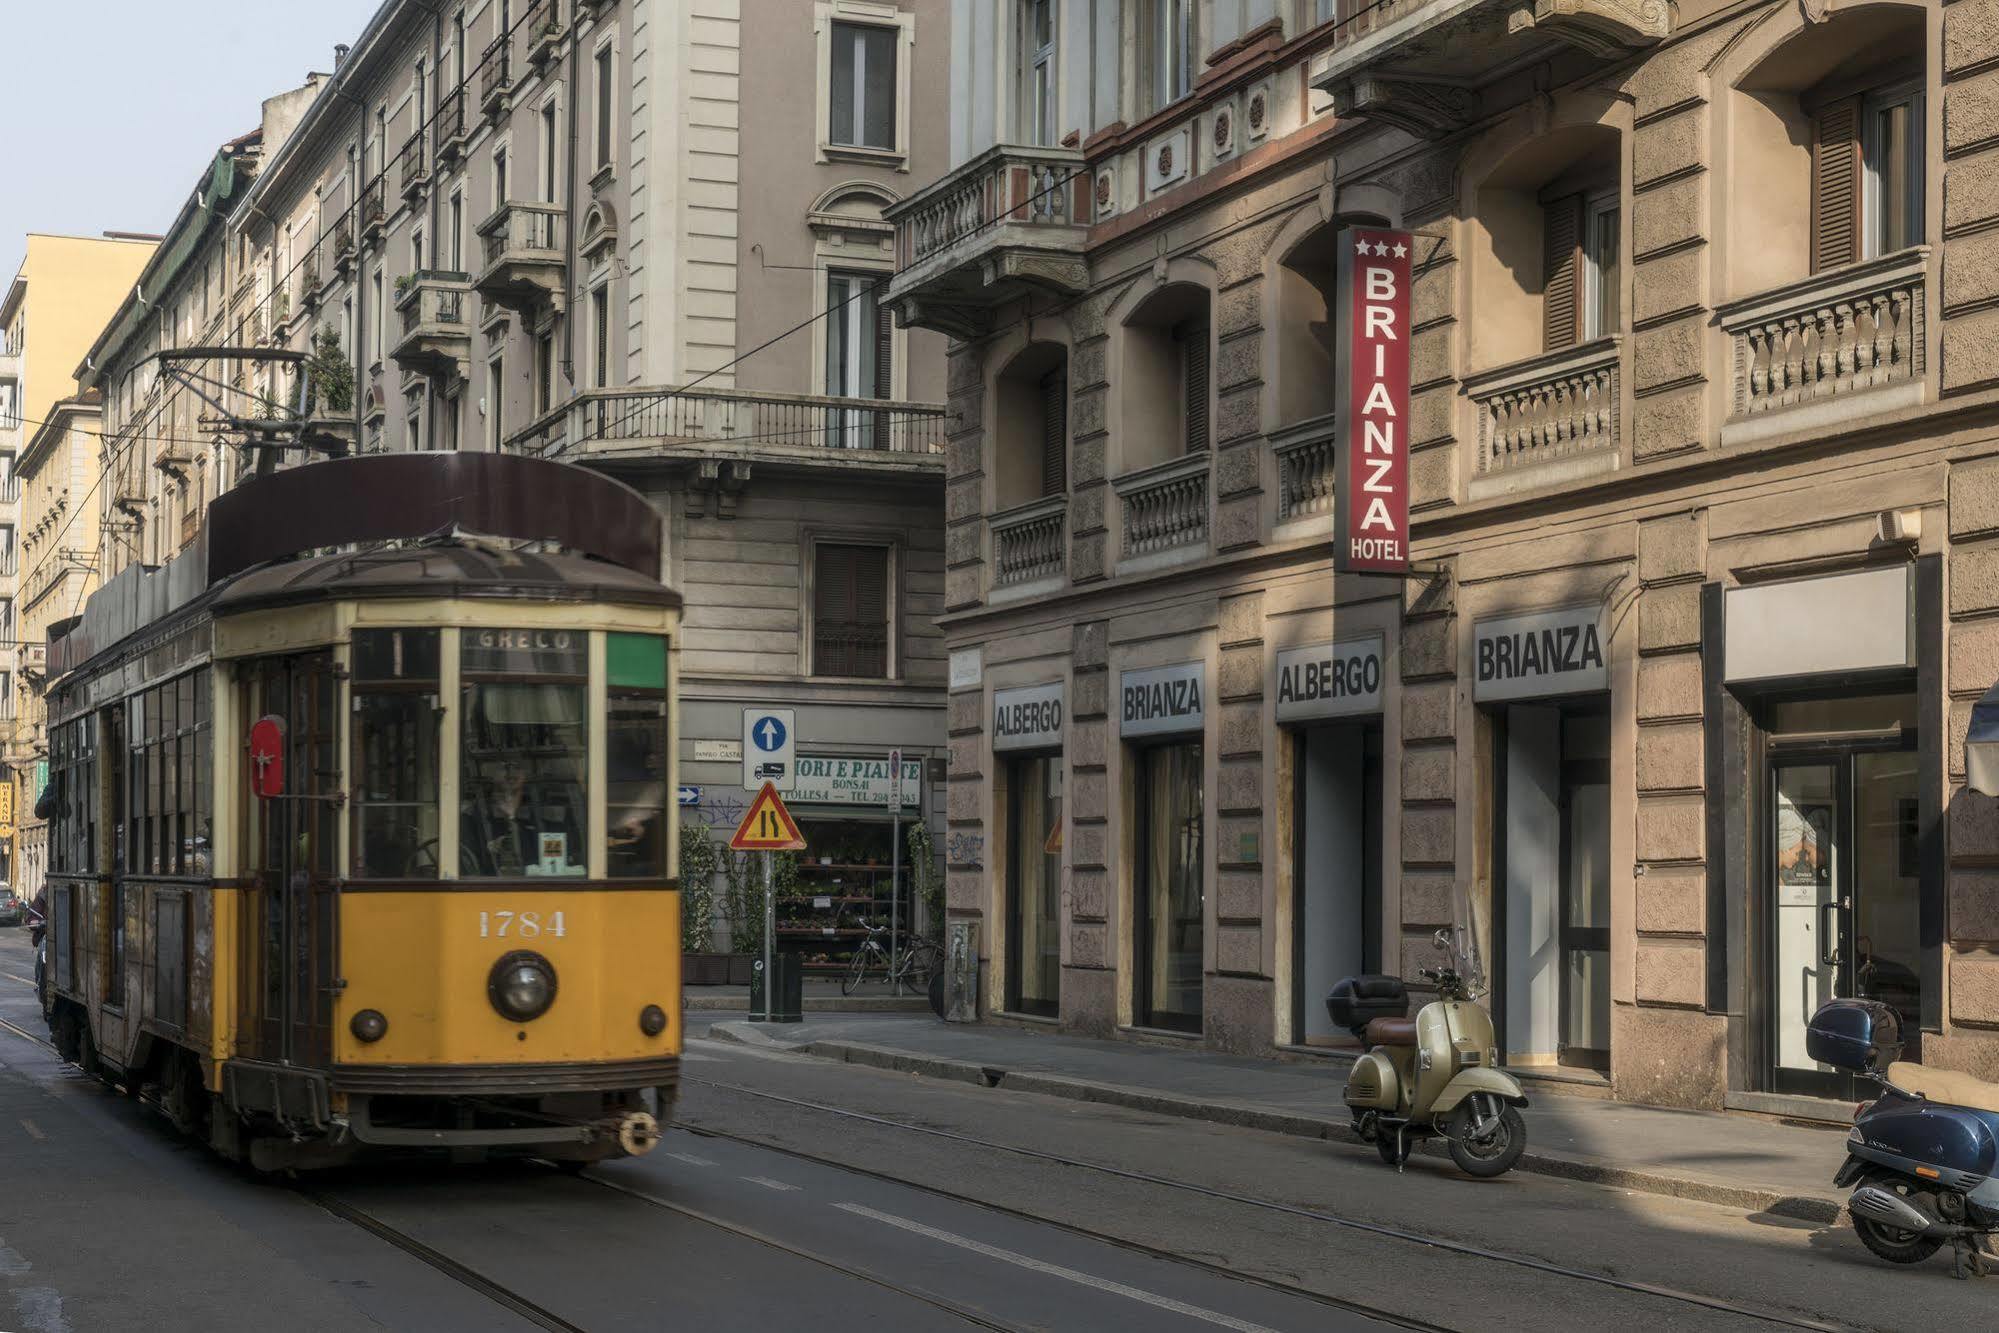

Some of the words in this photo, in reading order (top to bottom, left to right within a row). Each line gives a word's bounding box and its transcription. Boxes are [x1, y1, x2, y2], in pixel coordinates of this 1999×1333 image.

[1360, 267, 1397, 531] BRIANZA
[1351, 538, 1403, 561] HOTEL
[1478, 623, 1604, 682] BRIANZA
[1278, 653, 1380, 704] ALBERGO
[995, 698, 1062, 737] ALBERGO
[1124, 678, 1201, 722] BRIANZA
[832, 779, 869, 790] BONSAI
[837, 760, 847, 778] E
[851, 761, 919, 779] PIATE
[479, 910, 567, 938] 1784
